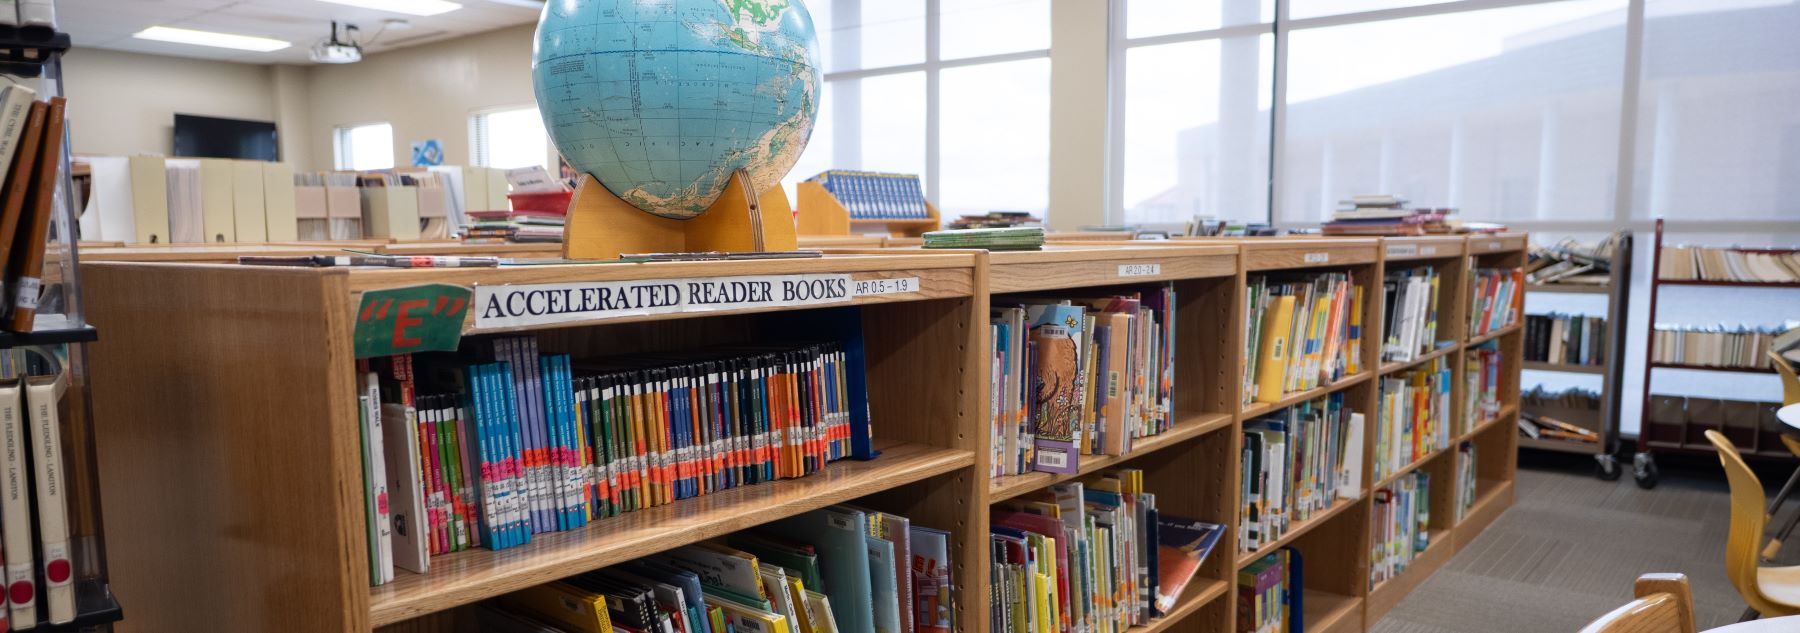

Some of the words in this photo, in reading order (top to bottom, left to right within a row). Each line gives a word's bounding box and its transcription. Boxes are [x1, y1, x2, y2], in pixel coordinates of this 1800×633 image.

[1125, 265, 1133, 274] AR
[855, 281, 869, 294] AR
[871, 280, 885, 293] 0.5
[895, 279, 908, 292] 1.9
[482, 284, 681, 319] ACCELERATED
[687, 281, 773, 304] READER
[782, 278, 847, 301] BOOKS
[4, 406, 12, 421] THE
[40, 404, 48, 418] THE
